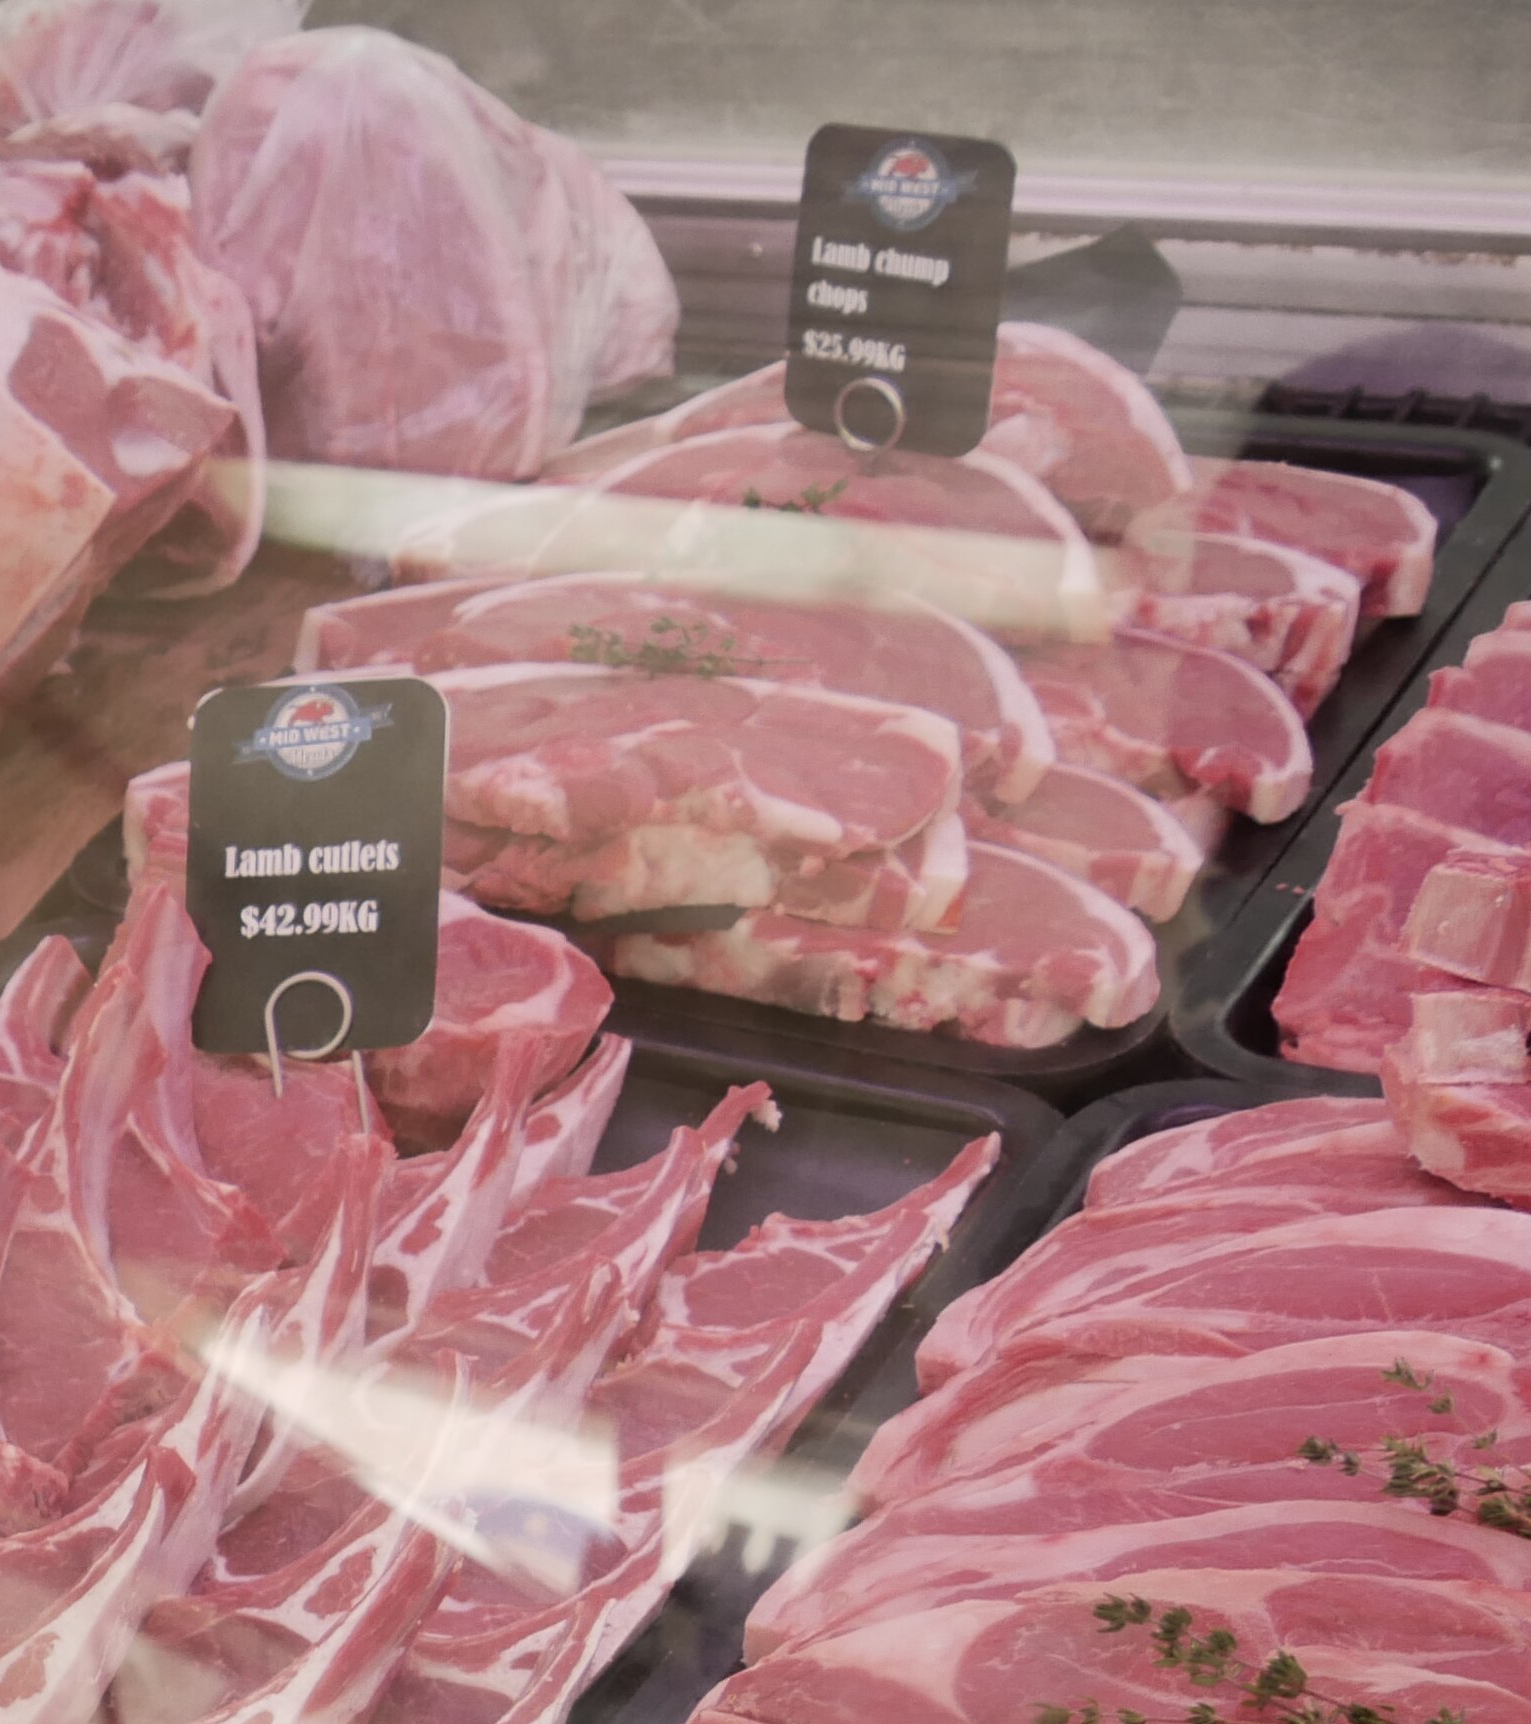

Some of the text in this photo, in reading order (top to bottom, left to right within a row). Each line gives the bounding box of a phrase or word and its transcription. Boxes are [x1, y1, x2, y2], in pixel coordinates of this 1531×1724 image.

[811, 236, 952, 288] Lamb chump
[805, 280, 869, 315] chops
[801, 328, 908, 373] $25.99KG
[268, 722, 352, 746] MID WEST
[224, 839, 402, 879] Lamb cutlets
[239, 900, 379, 940] $42.99KG
